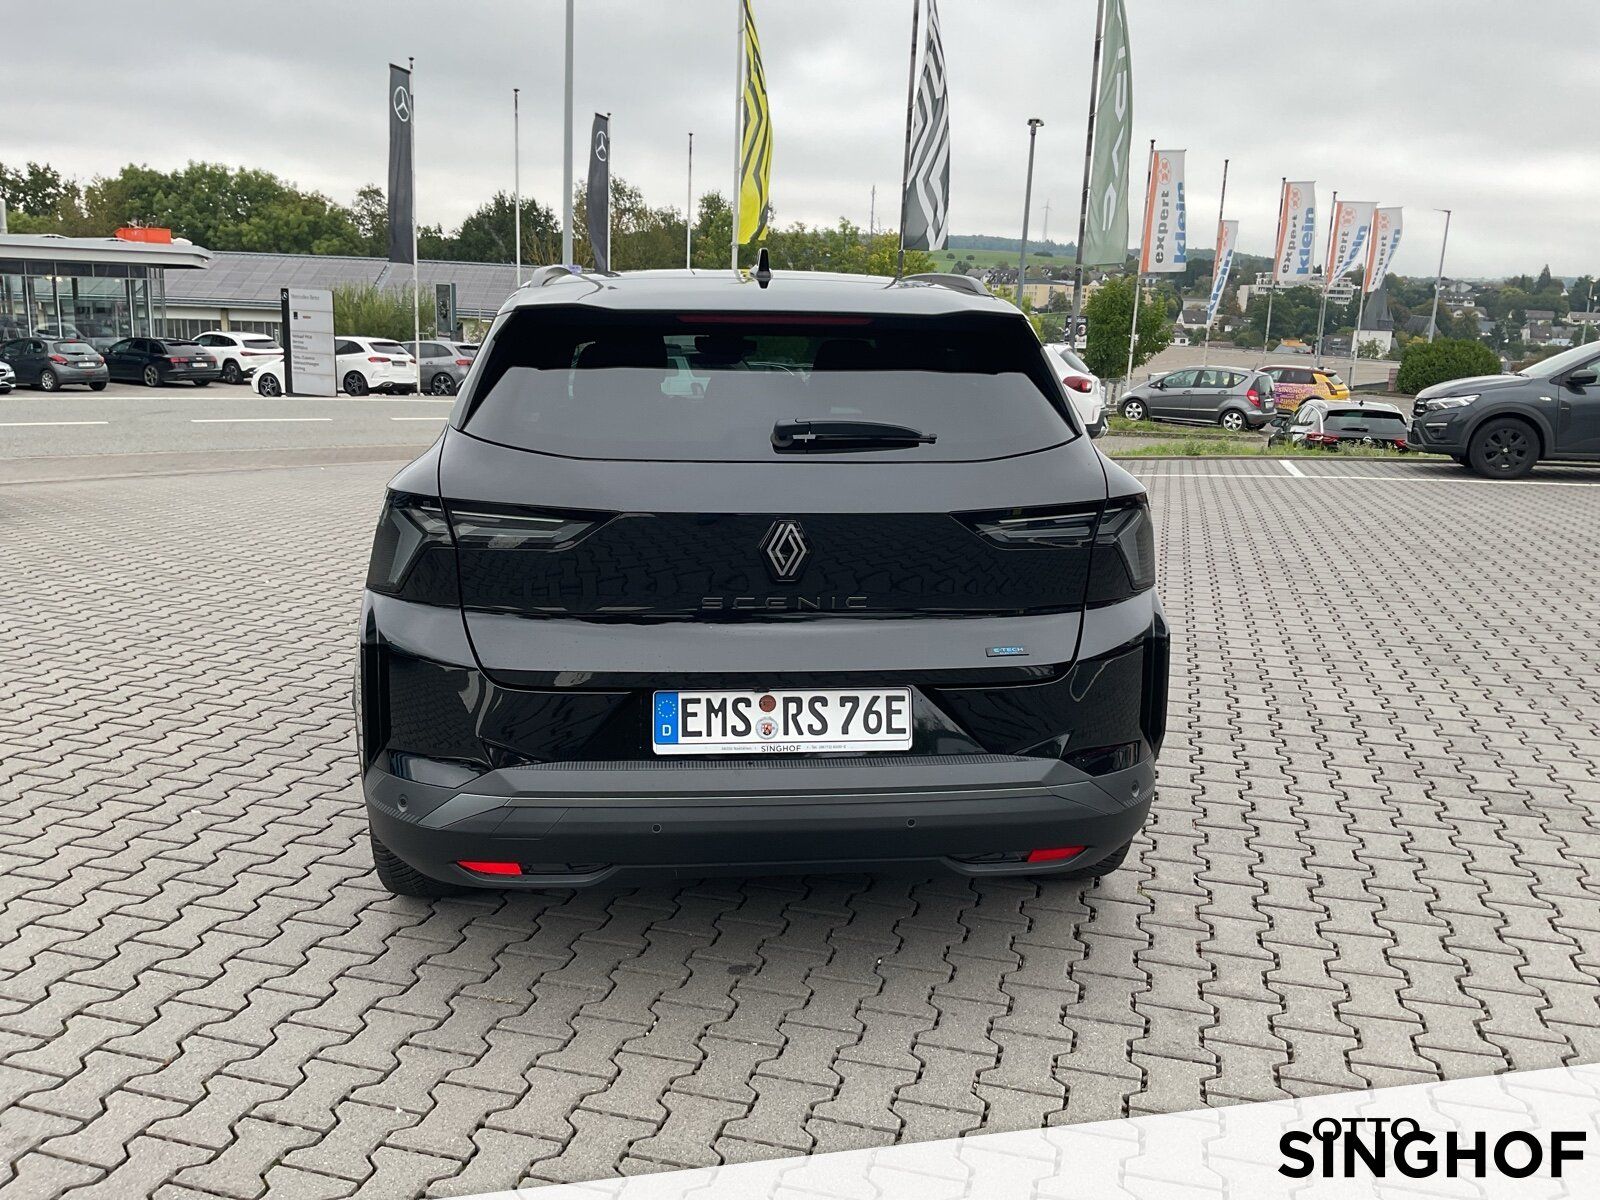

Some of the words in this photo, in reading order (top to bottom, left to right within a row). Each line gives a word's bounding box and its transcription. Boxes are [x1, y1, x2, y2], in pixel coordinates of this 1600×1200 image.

[1155, 190, 1169, 263] expert
[1174, 182, 1186, 263] klein
[1282, 214, 1298, 273] expert
[1296, 207, 1314, 274] klein
[702, 596, 867, 610] SCENIC
[662, 725, 671, 736] D
[681, 698, 752, 737] EMS
[782, 696, 829, 735] RS
[839, 695, 907, 735] 76E
[761, 745, 801, 753] SINGHOF
